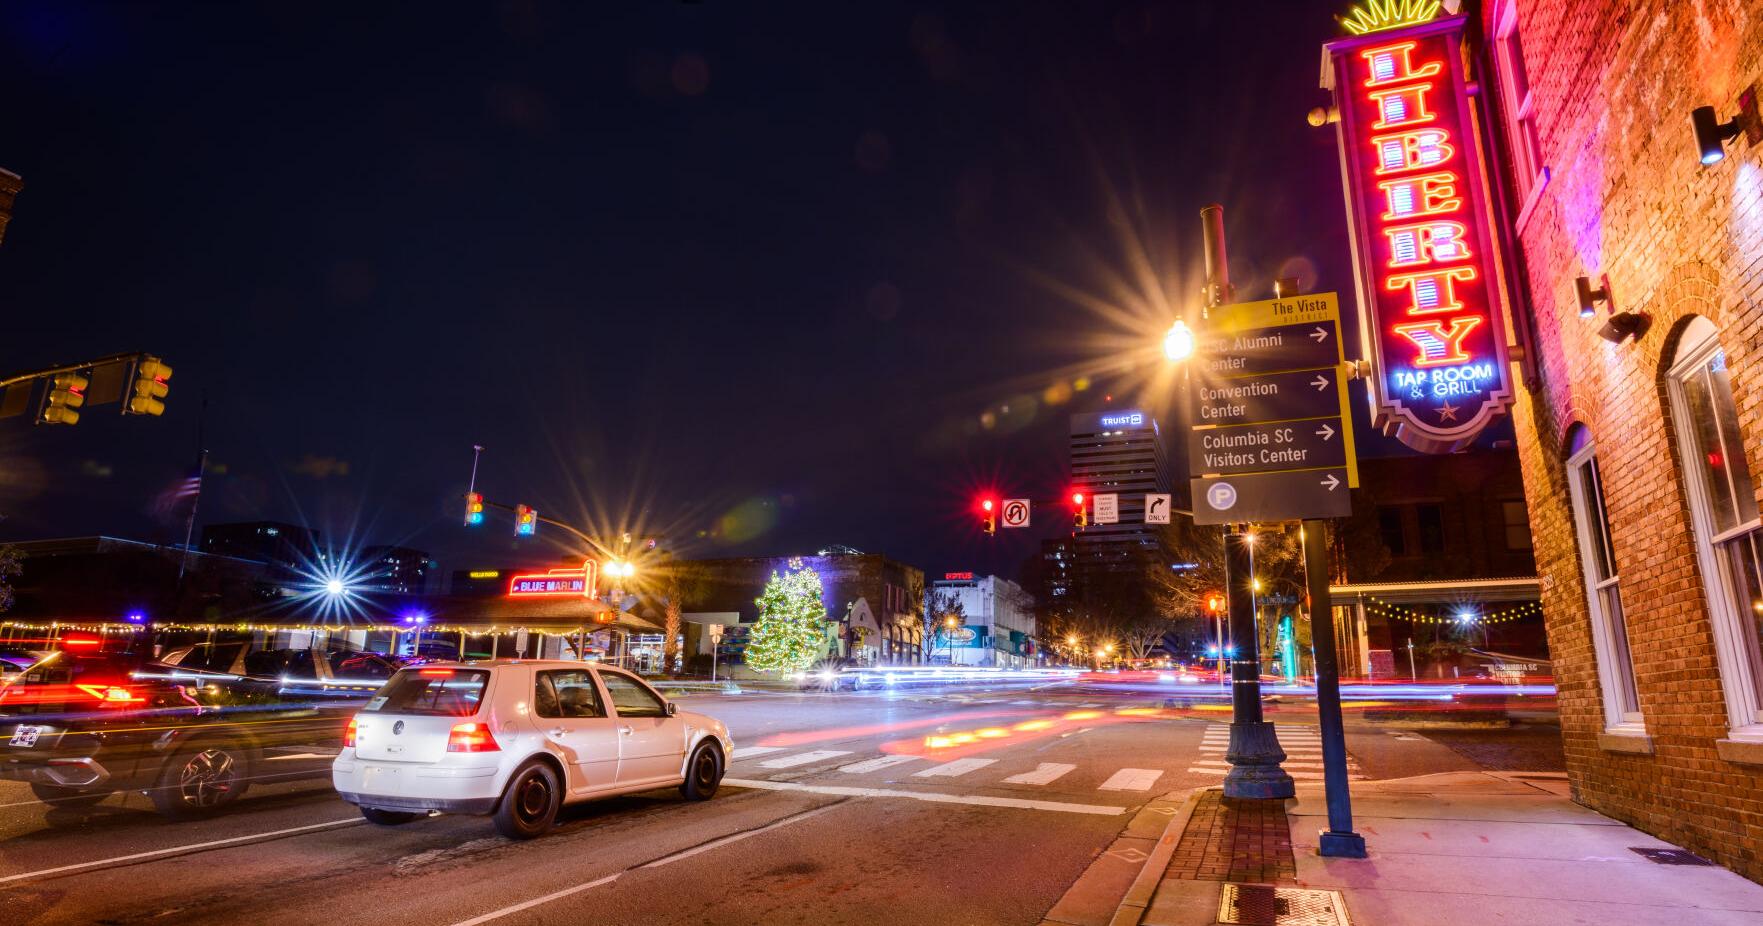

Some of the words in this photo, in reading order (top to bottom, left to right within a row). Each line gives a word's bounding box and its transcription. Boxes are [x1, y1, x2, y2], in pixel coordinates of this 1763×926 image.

[1362, 43, 1483, 368] LIBERTY
[1272, 301, 1294, 316] The
[1297, 299, 1328, 313] Vista
[1233, 332, 1283, 351] Alumni
[1396, 371, 1427, 387] TAP
[1432, 363, 1493, 383] ROOM
[1199, 381, 1279, 401] Convention
[1410, 384, 1424, 398] &
[1433, 380, 1483, 396] GRILL
[1201, 403, 1247, 419] Center
[1103, 416, 1131, 425] TRUIST
[1203, 430, 1269, 449] Columbia
[1274, 428, 1294, 443] SC
[1204, 451, 1256, 468] Visitors
[1260, 447, 1308, 464] Center
[1214, 488, 1232, 505] P
[520, 582, 545, 592] BLUE
[546, 581, 583, 591] MARLIN
